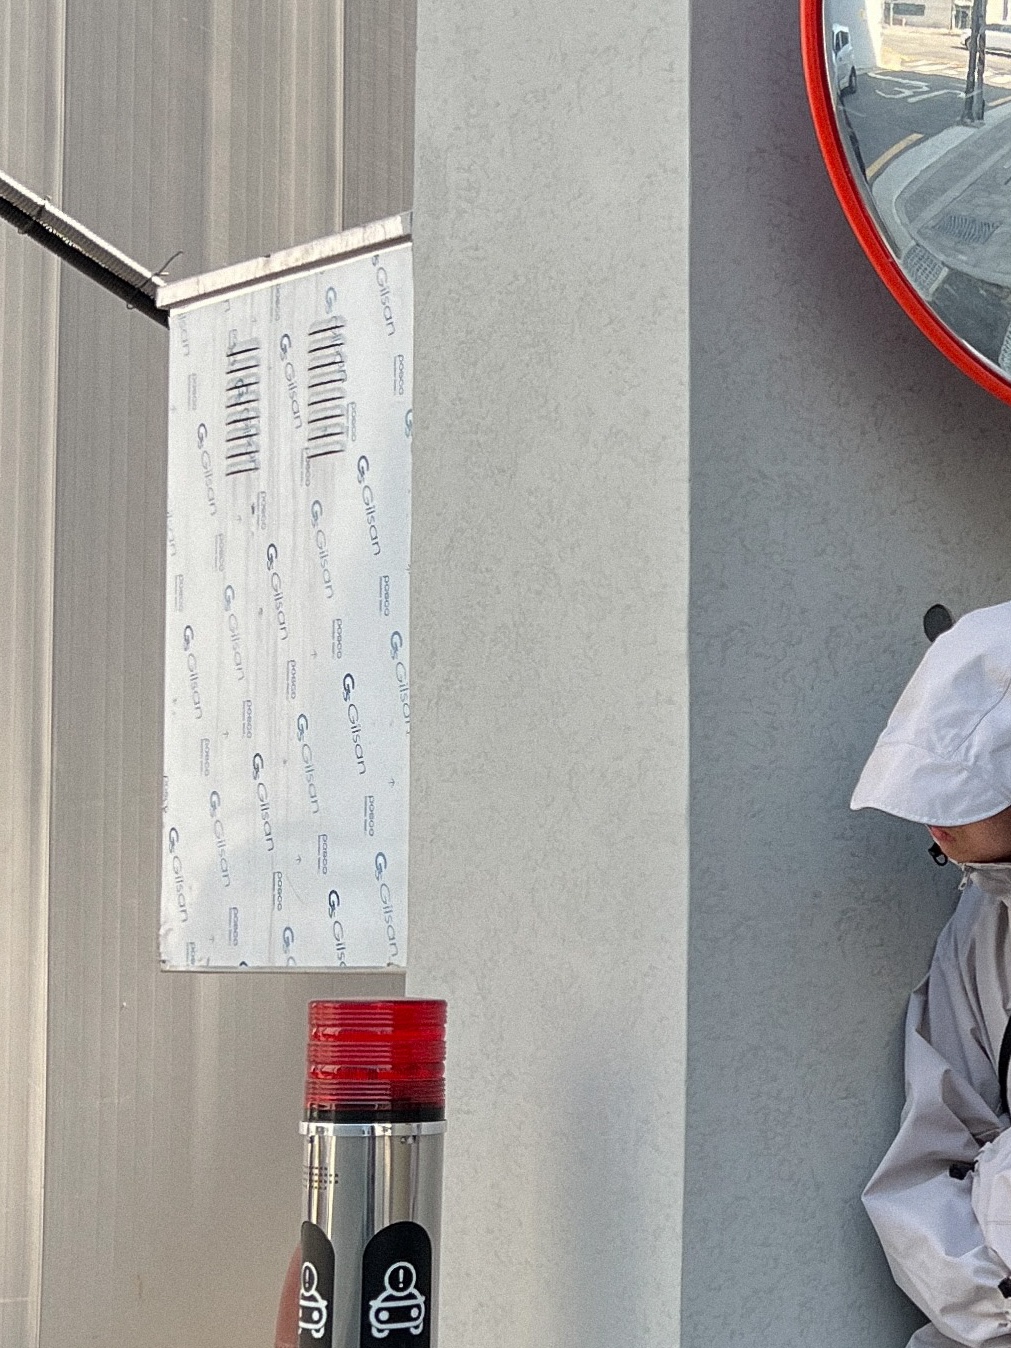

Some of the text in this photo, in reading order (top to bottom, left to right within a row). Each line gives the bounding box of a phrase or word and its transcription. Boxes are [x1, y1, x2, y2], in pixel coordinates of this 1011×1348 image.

[376, 267, 396, 337] Gilsan
[285, 362, 303, 430] Gilsan
[362, 485, 381, 556] Gilsan
[316, 529, 334, 599] Gilsan
[271, 572, 289, 641] Gilsan
[342, 672, 367, 775] Gs Gilsan
[301, 743, 320, 814] Gilsan
[257, 782, 275, 851] Gilsan
[172, 855, 189, 922] Gilsan
[214, 819, 231, 888] Gilsan
[328, 889, 348, 967] Gs Gils
[380, 883, 400, 957] Gilsan
